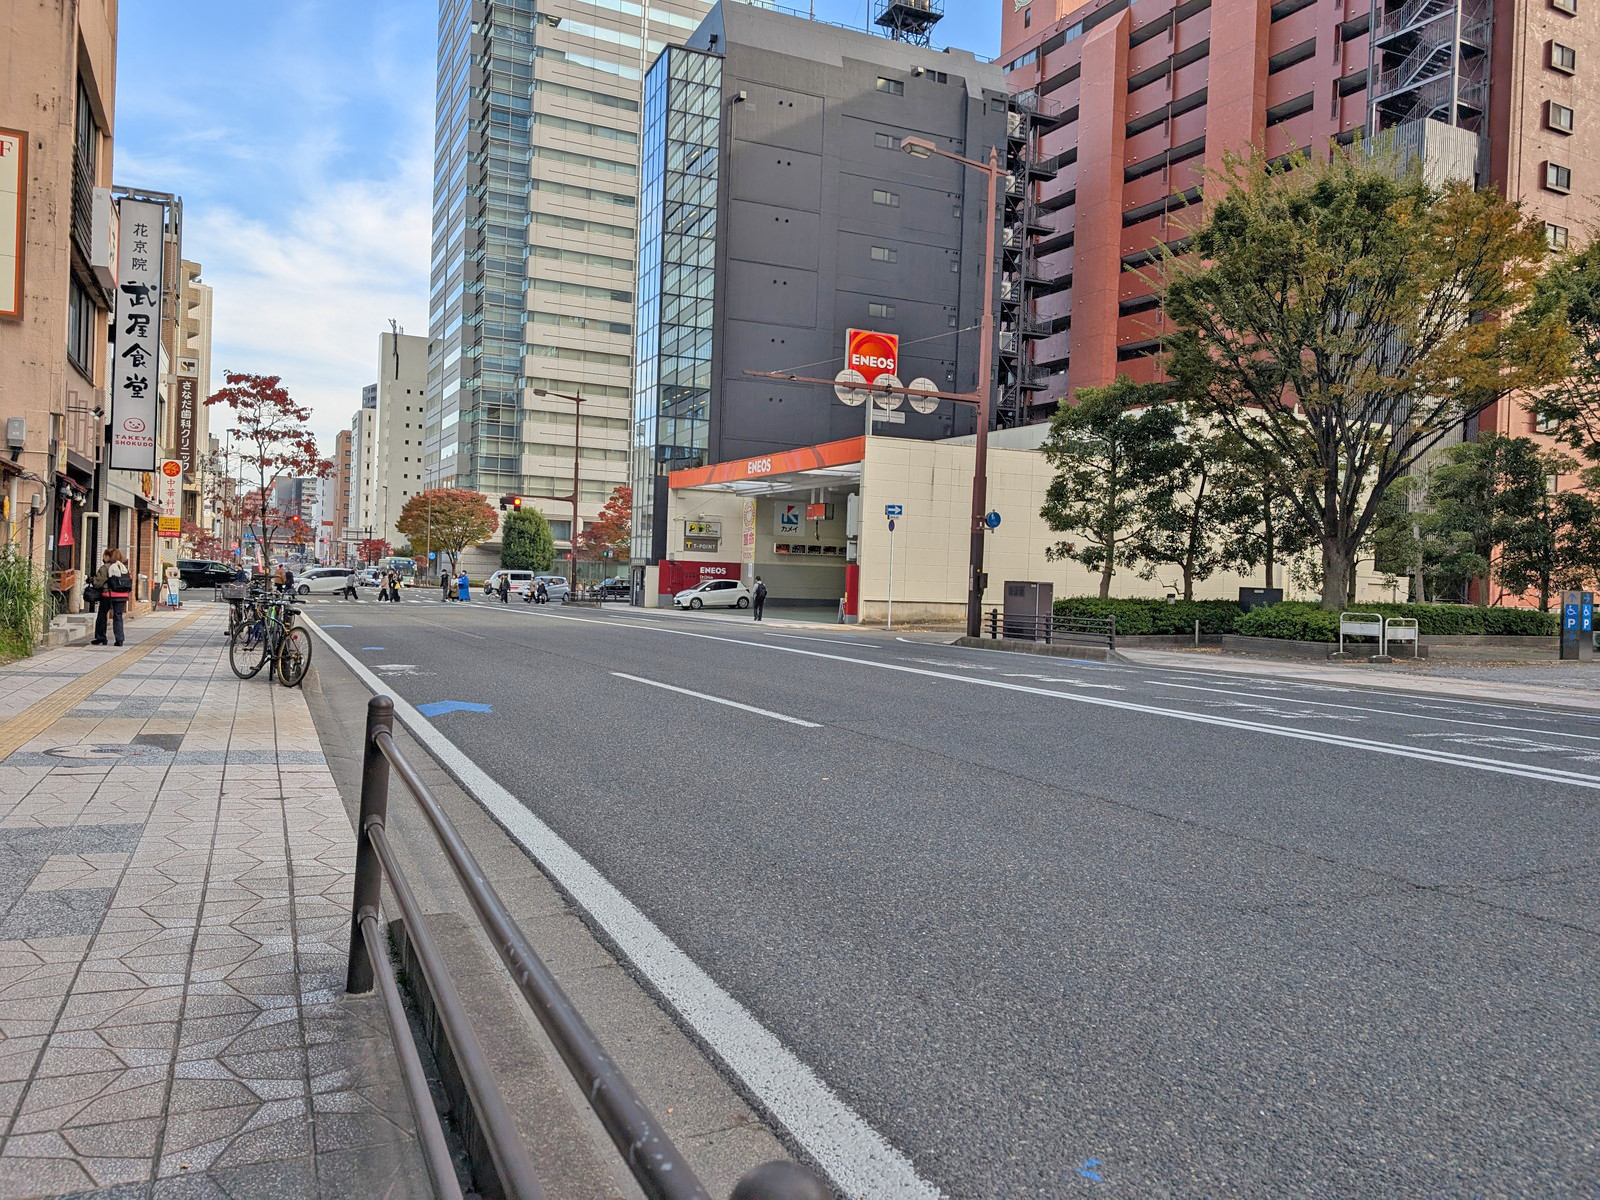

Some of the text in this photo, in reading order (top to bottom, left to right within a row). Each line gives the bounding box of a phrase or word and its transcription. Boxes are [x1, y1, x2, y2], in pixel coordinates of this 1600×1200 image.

[131, 222, 148, 272] 花京院
[120, 280, 158, 399] 武屋食堂
[852, 354, 895, 370] ENEOS
[114, 434, 153, 442] TAKEYA
[747, 458, 772, 475] ENEOS
[165, 478, 176, 516] 中華料理
[699, 566, 727, 575] ENEOS
[1568, 619, 1576, 628] P
[1584, 620, 1590, 629] P
